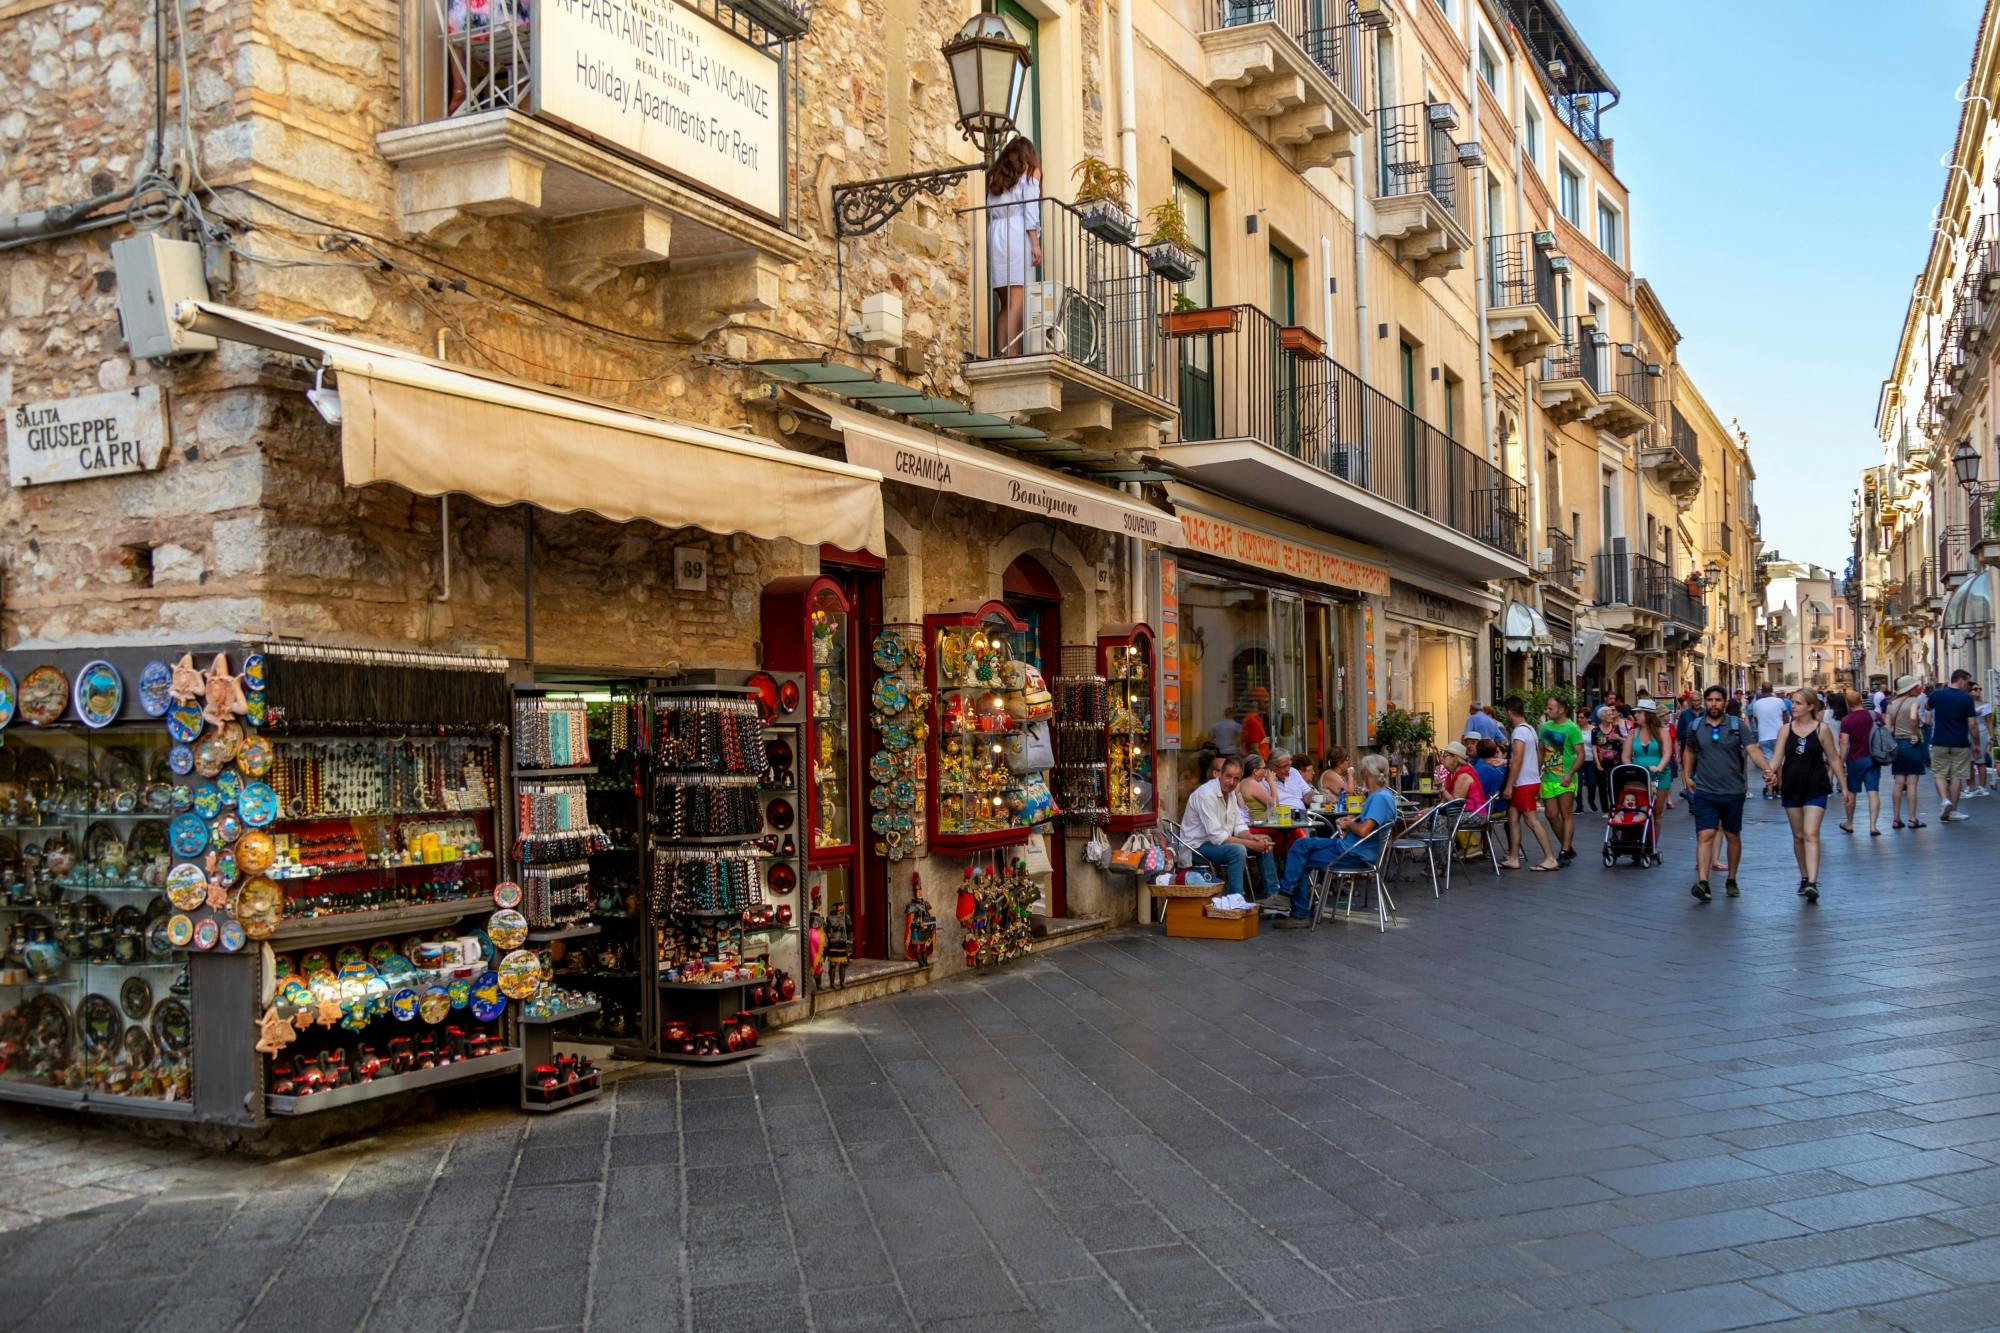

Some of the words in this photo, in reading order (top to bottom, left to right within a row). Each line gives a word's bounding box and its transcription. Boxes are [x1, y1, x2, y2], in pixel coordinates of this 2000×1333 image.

[635, 57, 659, 80] REAL
[662, 70, 691, 97] ESTATE
[682, 45, 709, 86] PER
[712, 58, 769, 120] VACANZE
[576, 48, 631, 114] Holiday
[633, 79, 706, 145] Apartments
[709, 117, 730, 155] For
[733, 129, 758, 171] Rent
[16, 407, 60, 428] SALITA
[28, 417, 119, 452] GIUSEPPE
[80, 439, 141, 470] CAPRI
[895, 450, 951, 484] CERAMICA
[1007, 478, 1079, 518] Bonsignore
[1123, 512, 1158, 538] SOUVENIR
[1213, 524, 1233, 555] BAR
[683, 560, 703, 579] 89
[1098, 570, 1108, 583] 87
[1494, 637, 1502, 700] HOTEL
